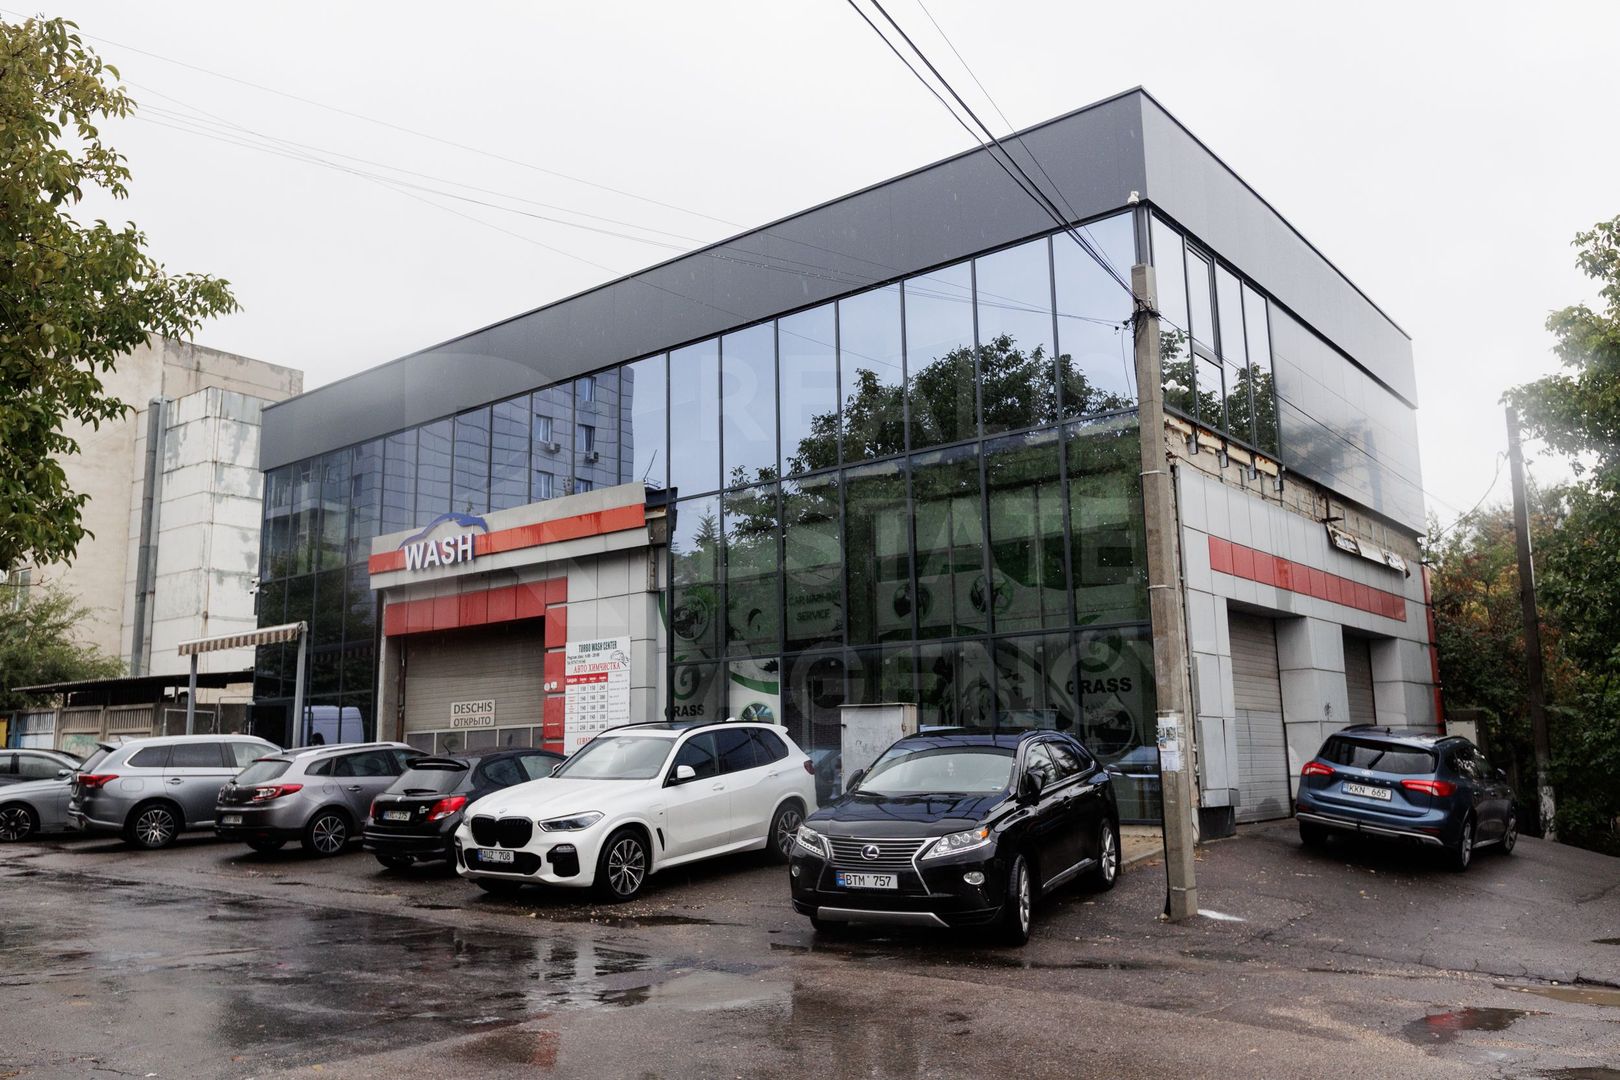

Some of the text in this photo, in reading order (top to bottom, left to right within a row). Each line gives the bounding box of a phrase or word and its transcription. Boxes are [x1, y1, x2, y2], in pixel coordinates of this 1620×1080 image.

[404, 533, 473, 571] WASH
[592, 642, 602, 651] WASH
[603, 640, 617, 650] CENTER
[573, 664, 588, 674] АВТО
[588, 662, 620, 672] ХИМЧИСТКА
[1065, 677, 1132, 695] GRASS
[454, 702, 492, 714] DESCHIS
[454, 716, 491, 727] ОТКРЫТО
[1349, 784, 1387, 798] KKN 665
[499, 851, 510, 860] 708
[846, 874, 891, 887] BTM 757
